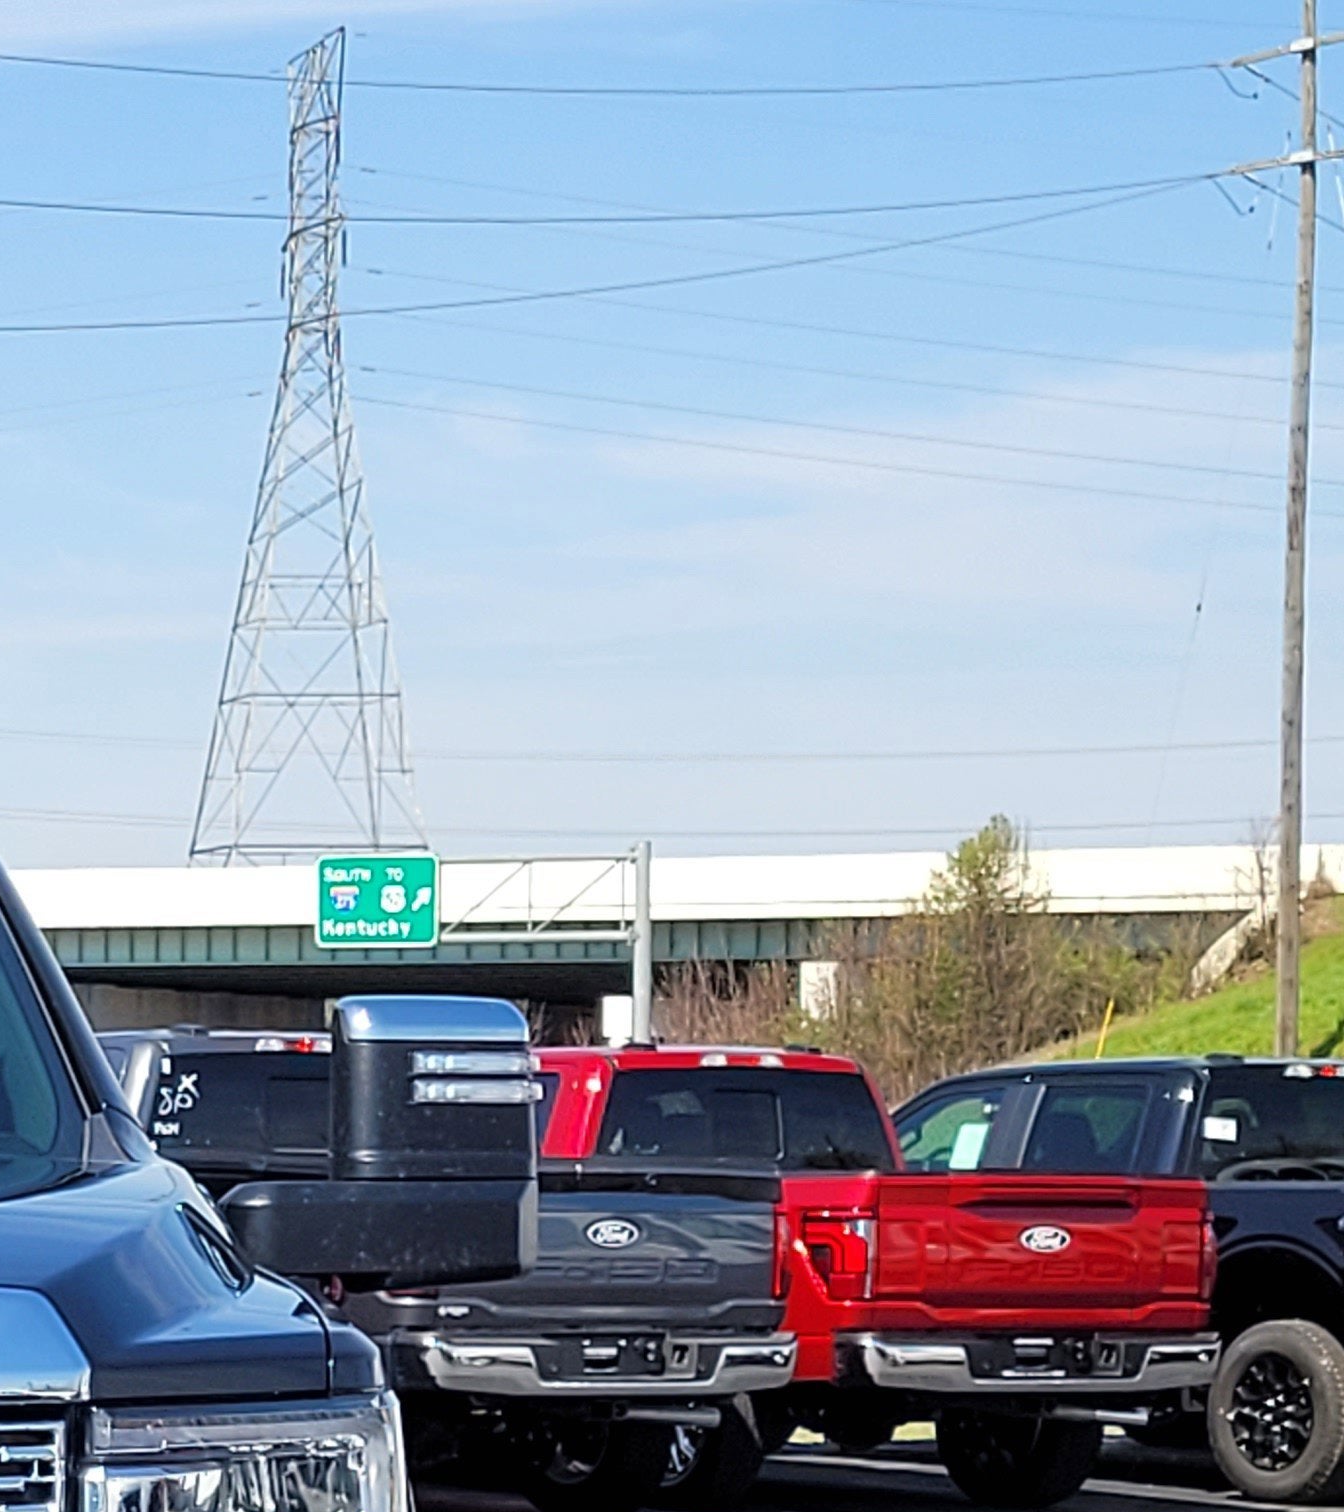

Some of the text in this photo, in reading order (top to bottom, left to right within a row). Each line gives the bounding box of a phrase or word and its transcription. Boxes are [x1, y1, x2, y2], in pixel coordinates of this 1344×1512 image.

[323, 866, 405, 882] SOUTH TO
[322, 918, 411, 939] Kentucky
